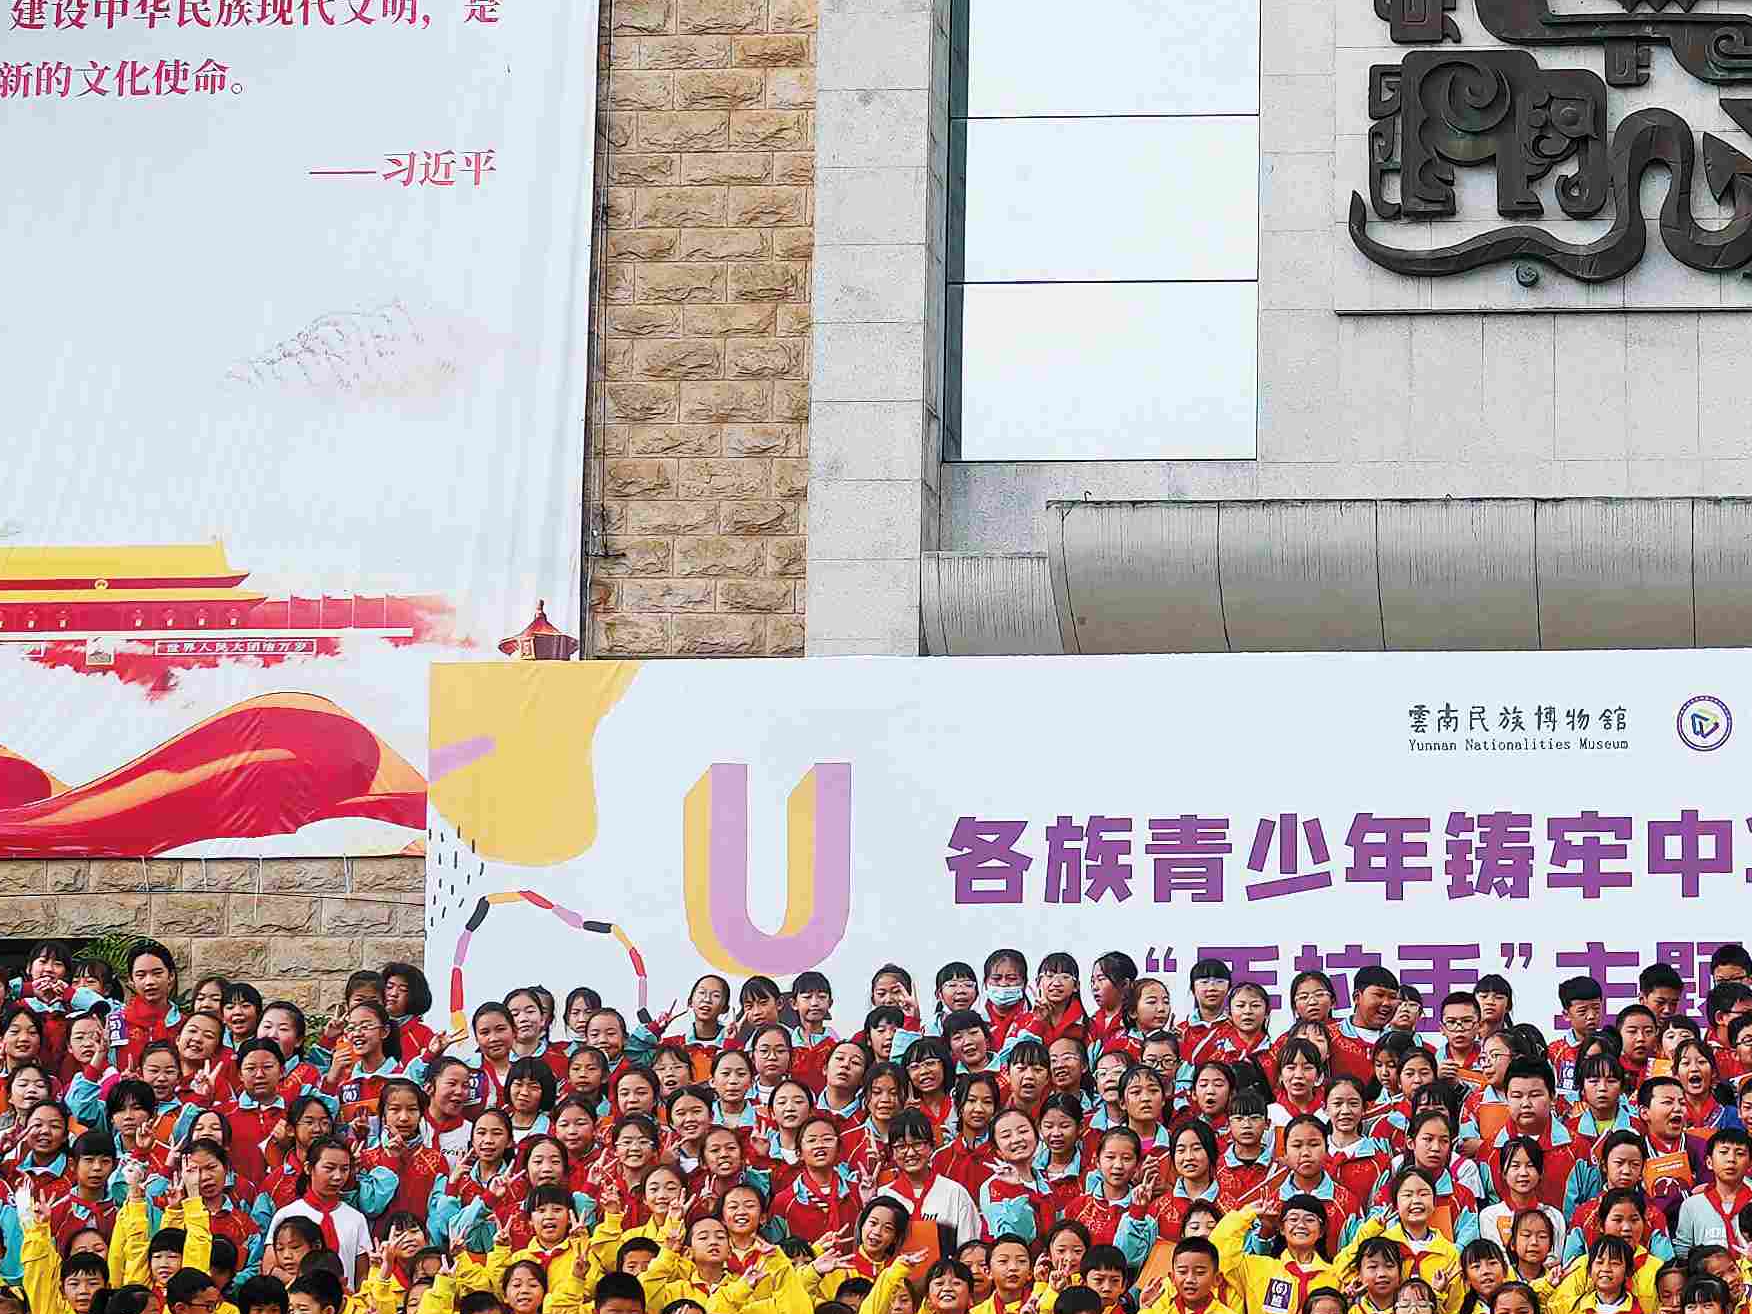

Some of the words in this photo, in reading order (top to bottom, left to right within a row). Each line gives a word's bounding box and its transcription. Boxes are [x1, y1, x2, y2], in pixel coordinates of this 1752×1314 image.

[1408, 738, 1457, 752] Yunnan
[1464, 737, 1571, 751] Nationalities
[1579, 737, 1629, 750] Museum
[683, 763, 851, 977] U
